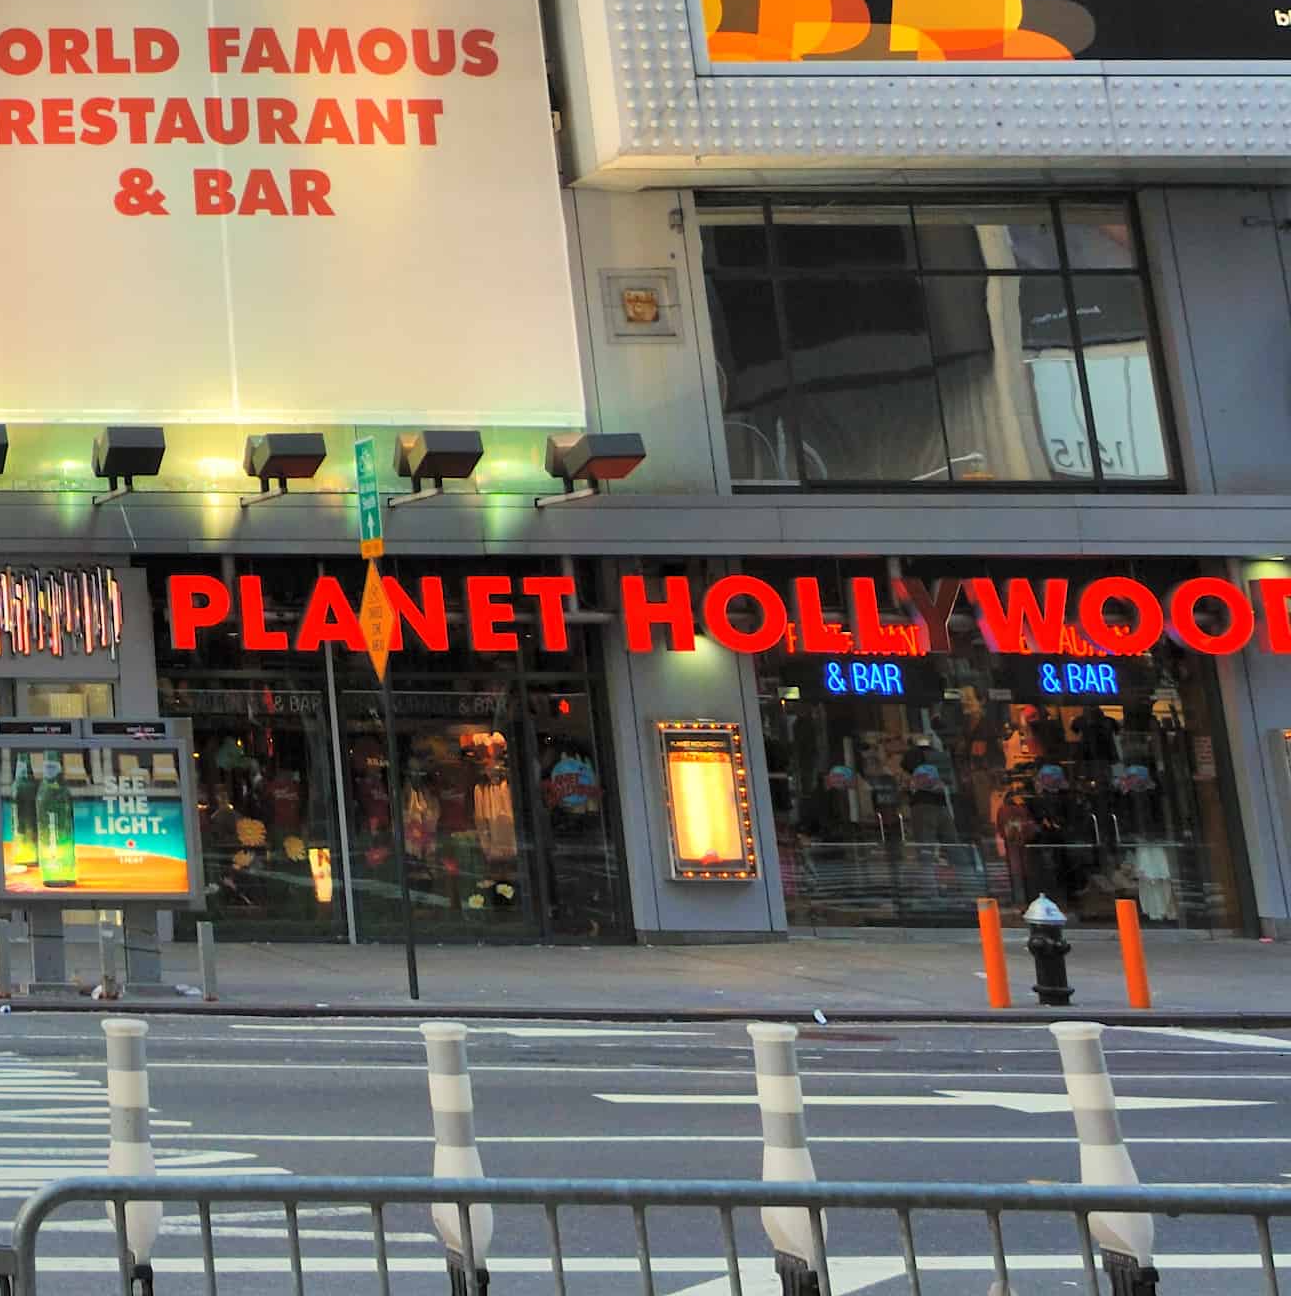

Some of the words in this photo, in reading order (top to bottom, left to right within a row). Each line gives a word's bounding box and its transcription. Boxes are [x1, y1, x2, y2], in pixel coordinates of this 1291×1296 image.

[207, 27, 499, 77] FAMOUS
[113, 168, 171, 216] &
[192, 168, 336, 216] BAR
[166, 575, 576, 652] PLANET
[827, 662, 847, 693] &
[851, 662, 903, 695] BAR
[1042, 662, 1062, 693] &
[1067, 662, 1118, 694] BAR
[104, 776, 147, 794] SEE
[102, 796, 150, 814] THE
[94, 815, 168, 835] LIGHT.
